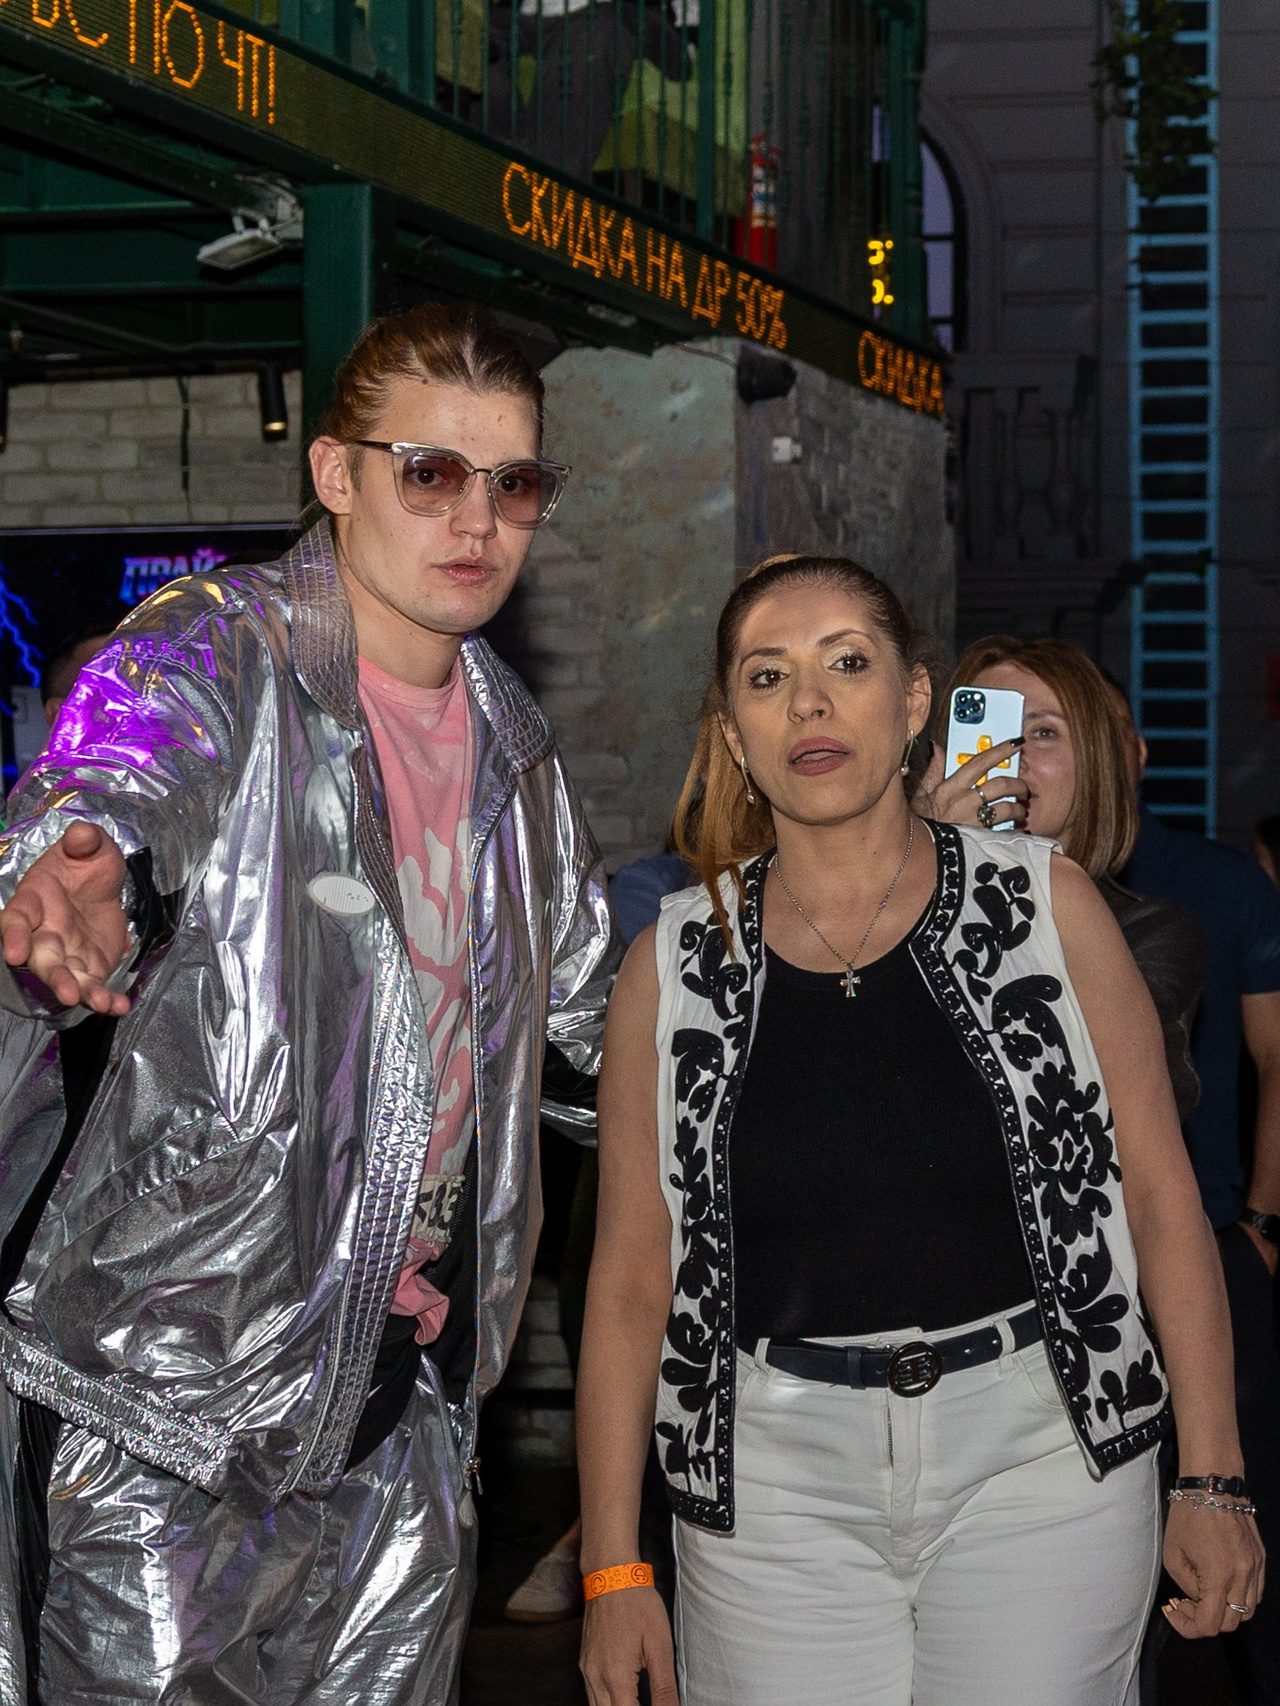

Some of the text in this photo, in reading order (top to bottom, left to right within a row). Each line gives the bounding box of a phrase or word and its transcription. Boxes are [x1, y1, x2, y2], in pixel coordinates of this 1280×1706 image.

[502, 161, 640, 286] СКИДКА
[647, 227, 688, 307] НА
[691, 254, 731, 328] ДР
[736, 270, 788, 350] 50%
[858, 330, 944, 419] СКИДКА
